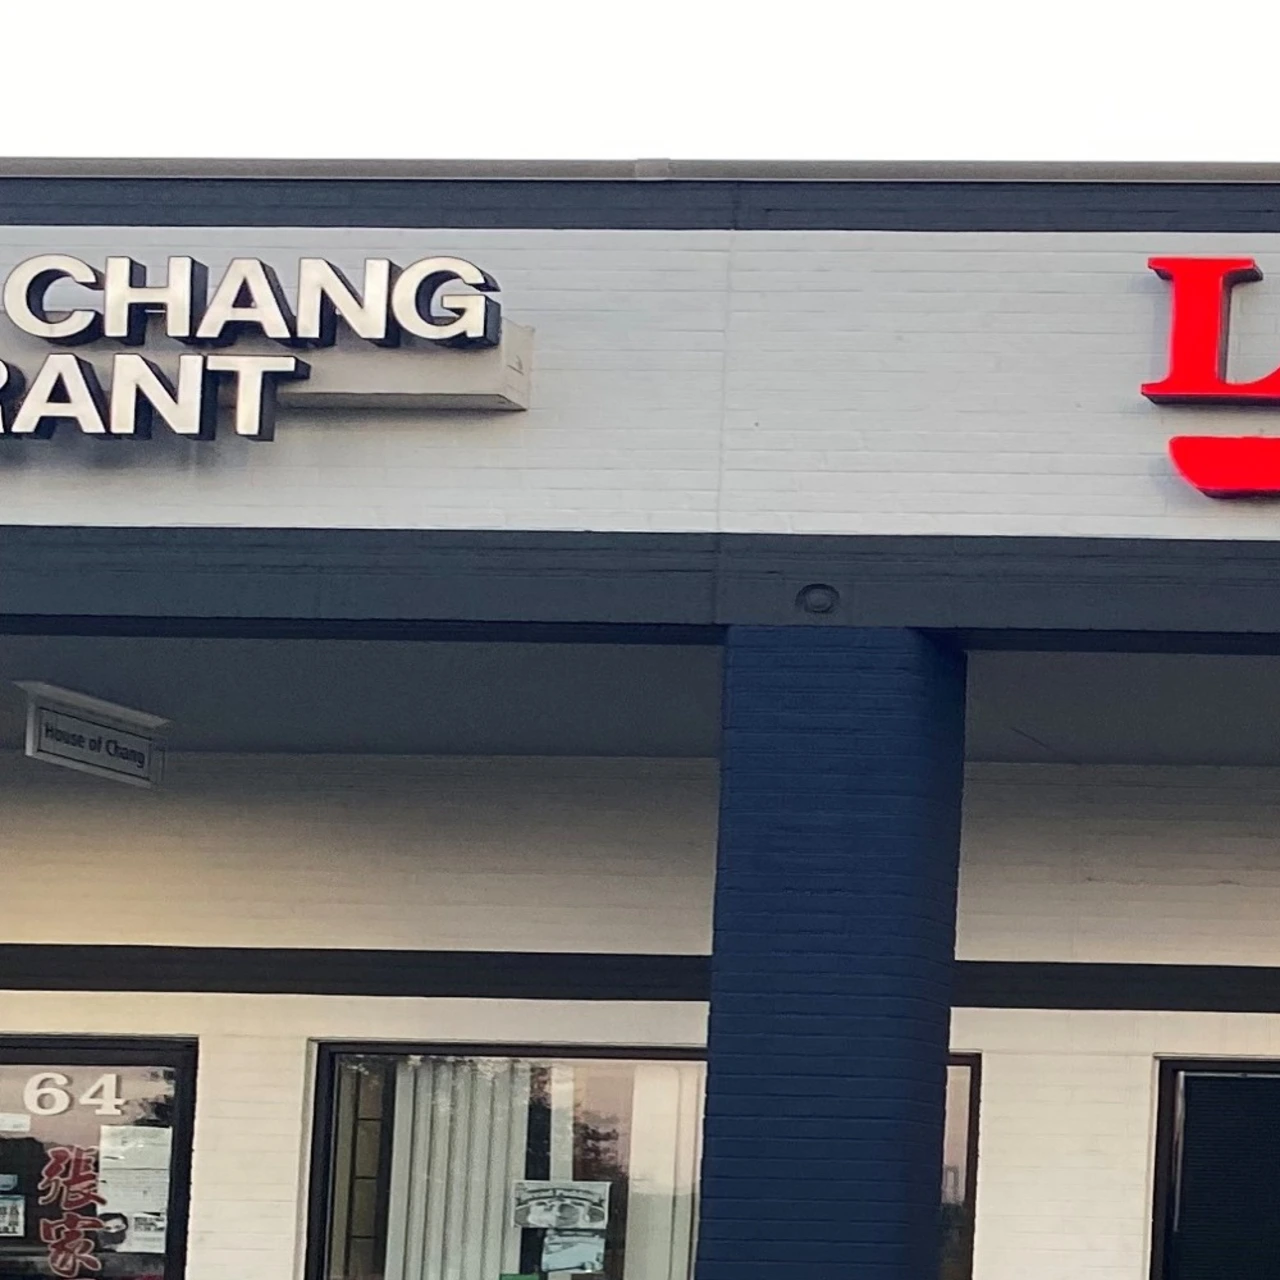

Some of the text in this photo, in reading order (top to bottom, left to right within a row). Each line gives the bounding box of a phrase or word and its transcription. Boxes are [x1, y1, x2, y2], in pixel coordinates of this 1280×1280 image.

[2, 253, 492, 341] CHANG
[0, 353, 297, 436] ANT
[44, 723, 146, 769] House of Chang
[23, 1072, 126, 1116] 64
